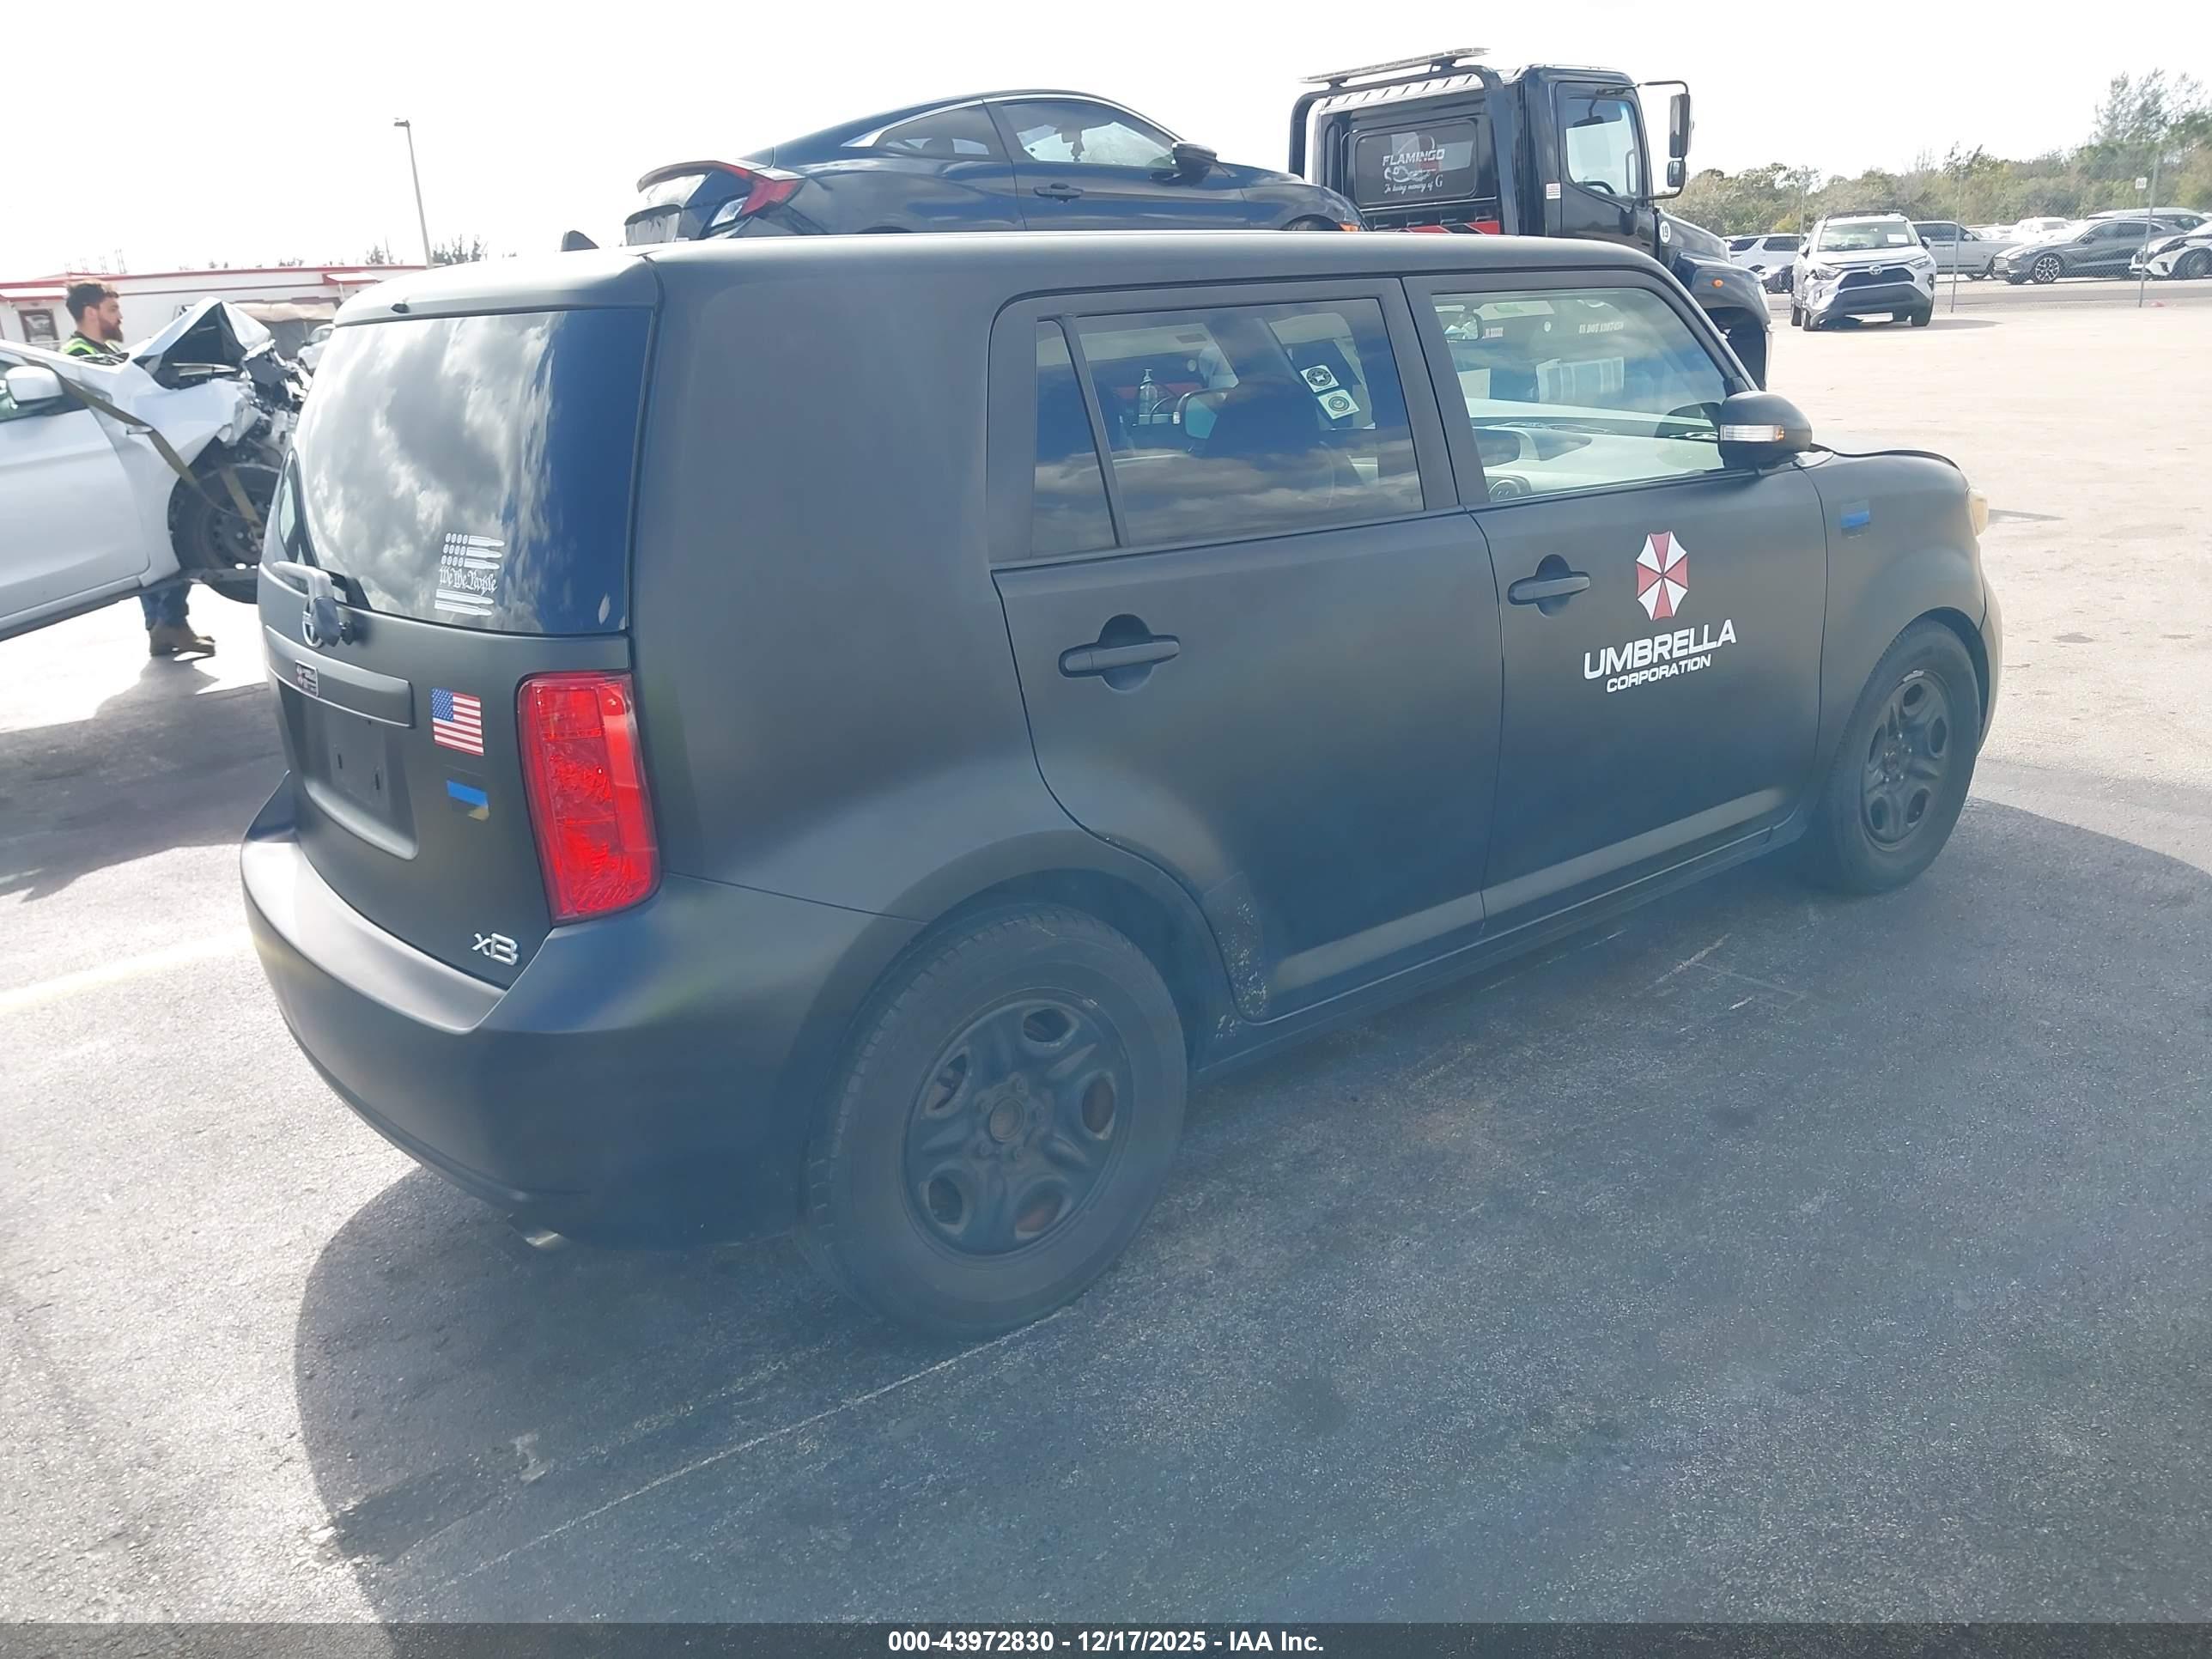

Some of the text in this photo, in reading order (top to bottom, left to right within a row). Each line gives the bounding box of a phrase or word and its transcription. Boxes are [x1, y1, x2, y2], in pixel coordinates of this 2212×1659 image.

[1382, 149, 1445, 167] FLAMINGO
[1435, 173, 1443, 187] G
[1662, 225, 1669, 238] 19
[1583, 618, 1736, 680] UMBRELLA
[1606, 653, 1711, 693] CORPORATION
